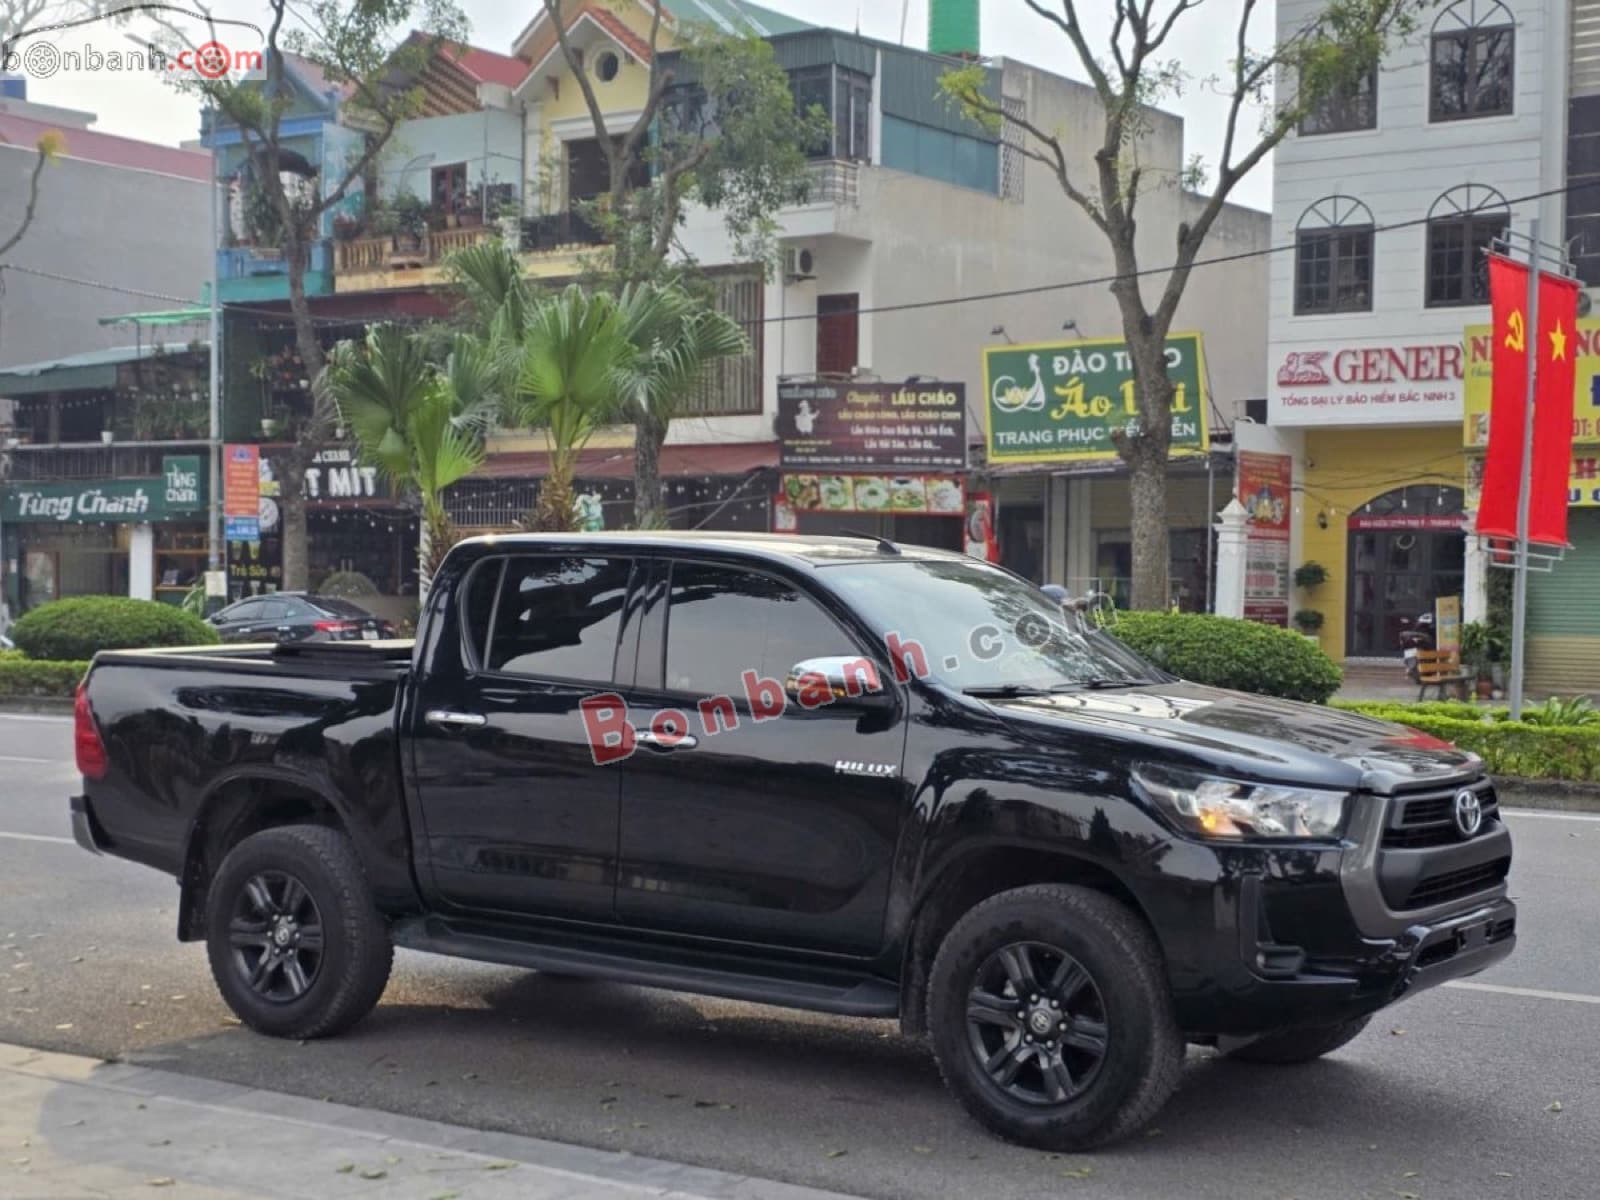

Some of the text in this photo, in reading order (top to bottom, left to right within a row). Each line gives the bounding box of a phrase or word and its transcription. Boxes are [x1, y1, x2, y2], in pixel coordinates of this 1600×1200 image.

[1052, 348, 1107, 376] ĐÀO
[1050, 376, 1113, 420] Áo
[996, 430, 1053, 445] TRANG
[1057, 427, 1104, 443] PHỤC
[328, 459, 376, 496] MÍT
[19, 488, 149, 520] Tùng Chanh
[835, 760, 897, 777] HILUX
